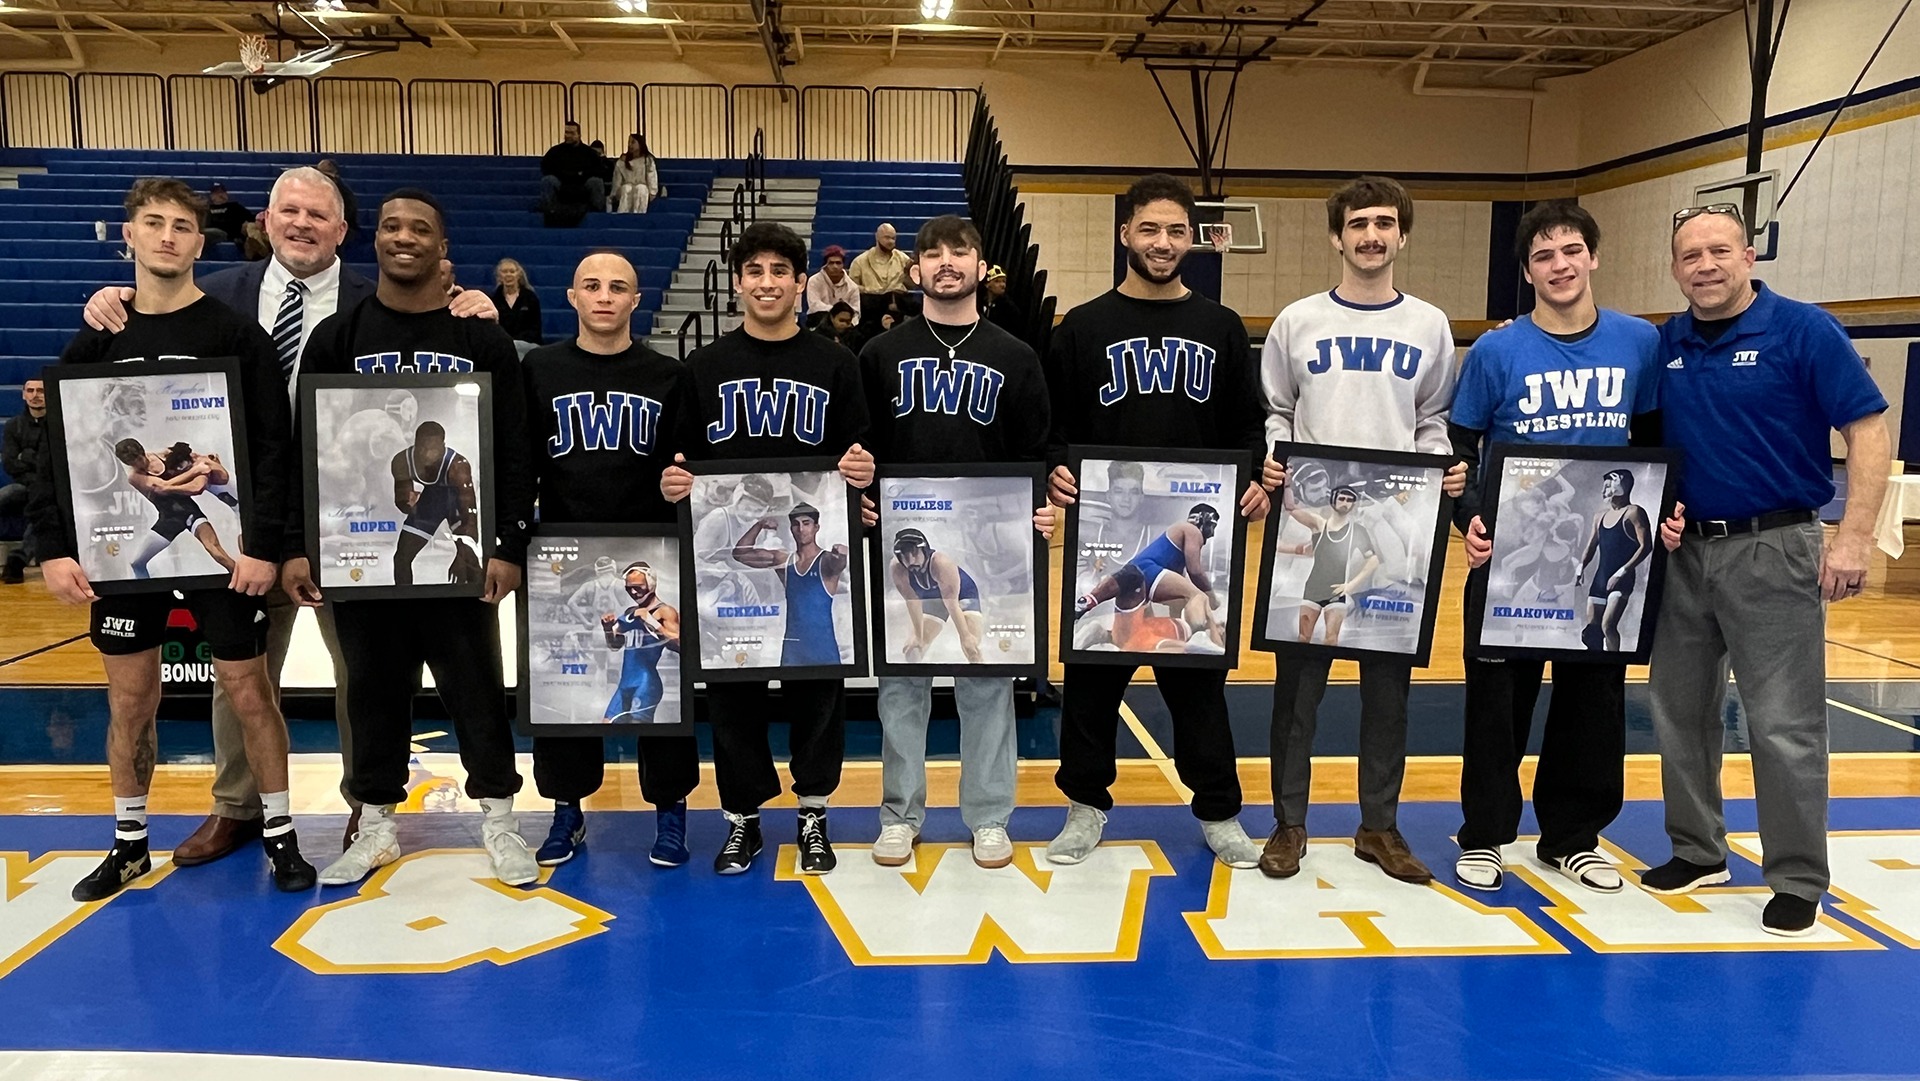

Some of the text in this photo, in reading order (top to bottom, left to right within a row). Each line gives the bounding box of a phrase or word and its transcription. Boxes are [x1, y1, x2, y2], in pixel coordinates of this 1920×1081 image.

[1307, 336, 1422, 380] JWU
[1099, 337, 1216, 406] JWU
[891, 357, 1005, 426] JWU
[1518, 367, 1626, 415] JWU
[171, 396, 225, 410] BROWN
[707, 378, 830, 446] JWU
[547, 391, 663, 458] JWU
[1513, 412, 1628, 435] WRESTLING
[1170, 481, 1222, 493] BAILEY
[892, 500, 953, 510] PUGLIESE
[350, 521, 397, 532] ROPER
[1493, 606, 1574, 620] KRAKOWER
[102, 616, 135, 631] JWU
[562, 664, 588, 675] FRY
